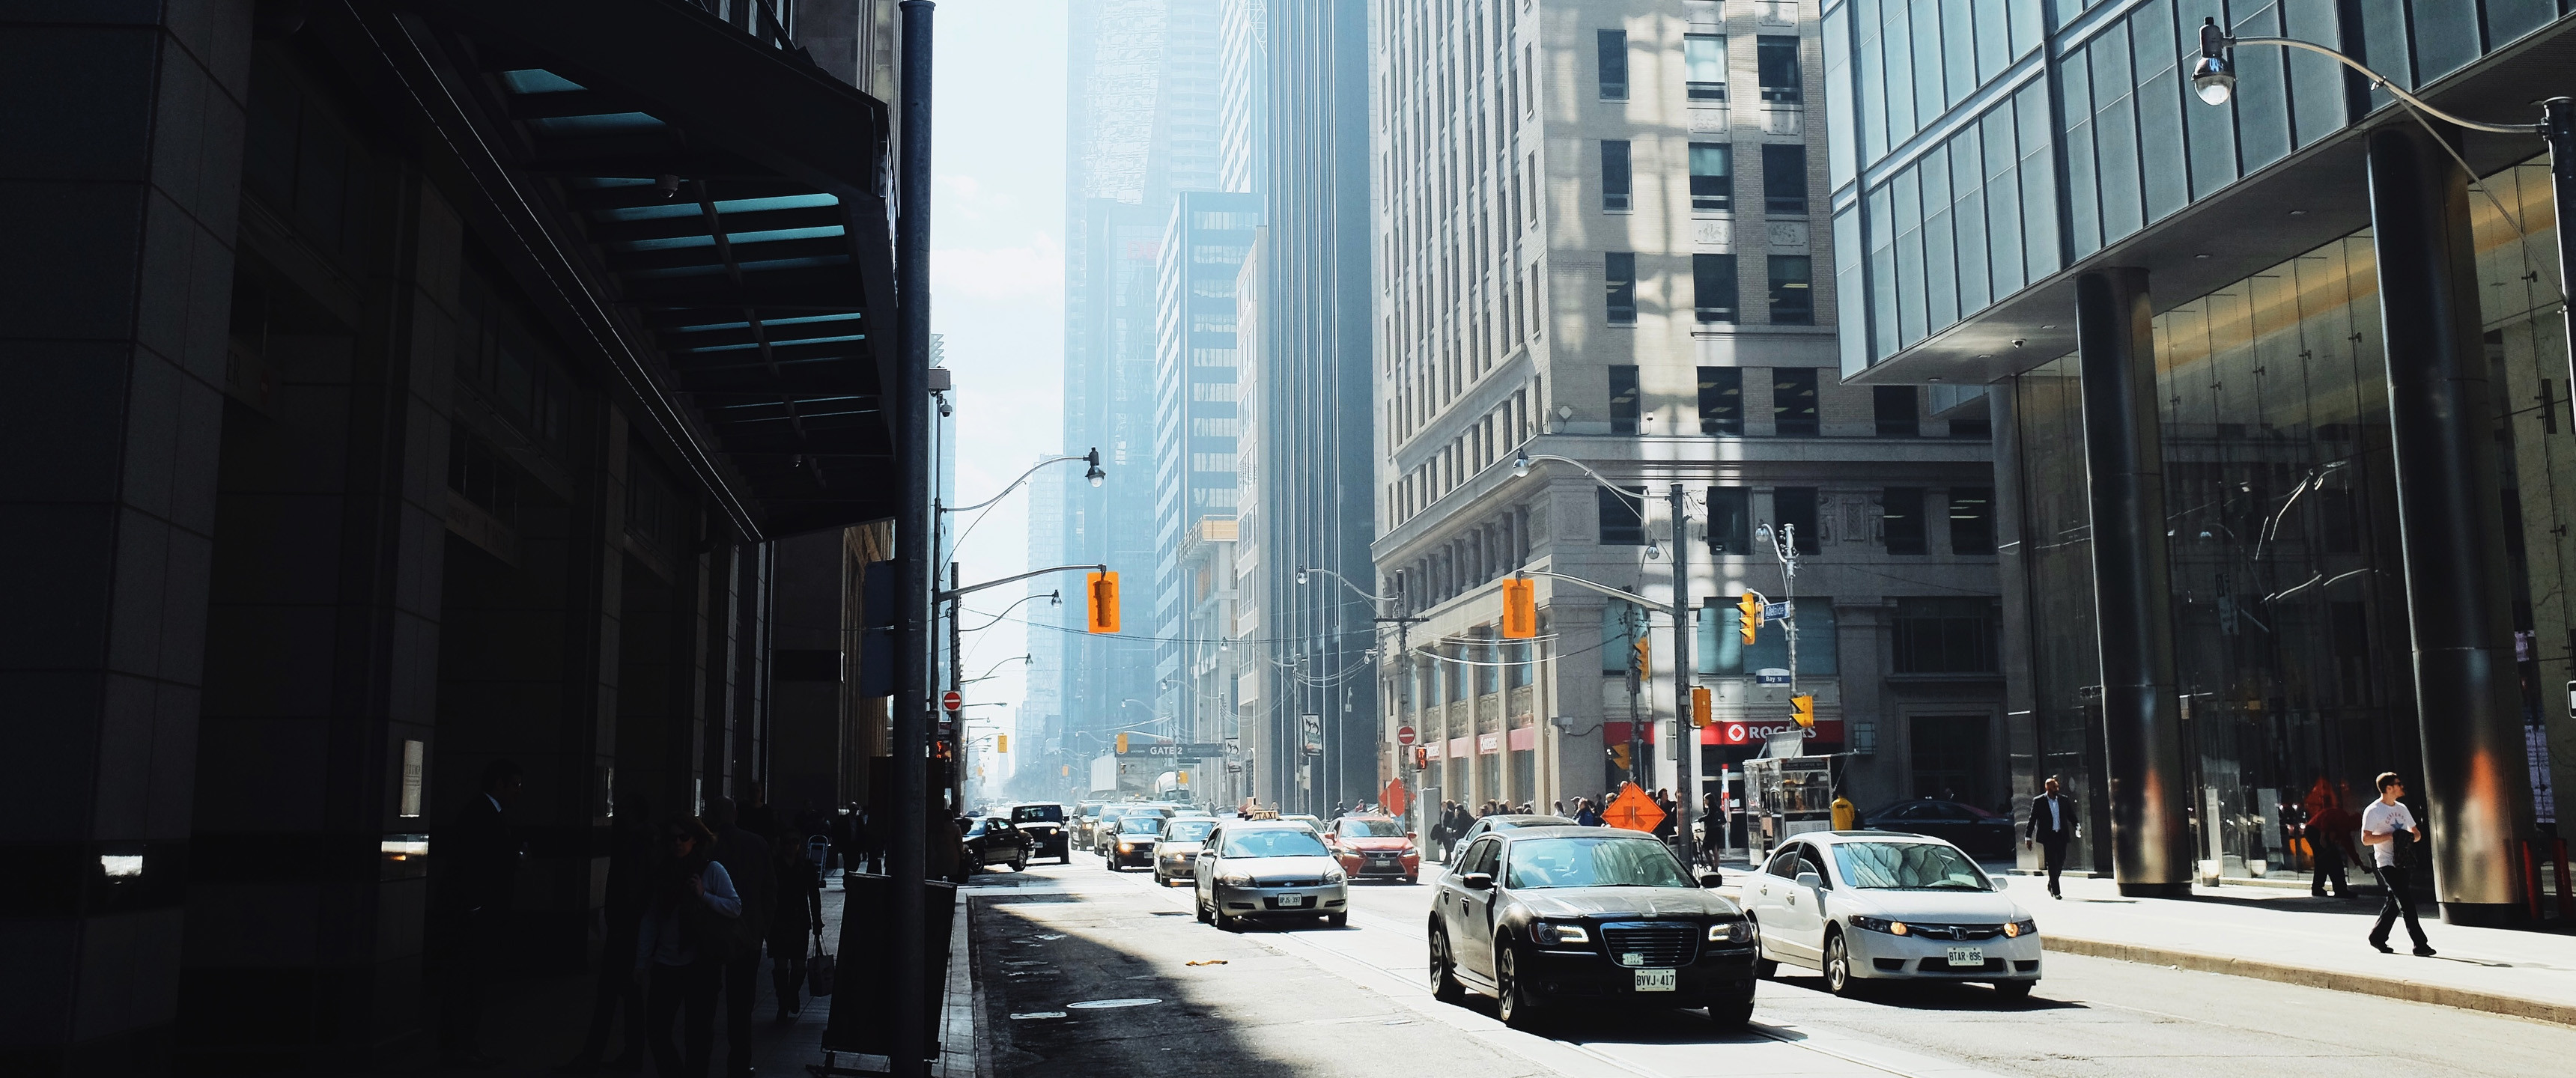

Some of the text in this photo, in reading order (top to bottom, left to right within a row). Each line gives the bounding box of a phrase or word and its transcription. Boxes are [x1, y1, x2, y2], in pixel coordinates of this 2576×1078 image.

[1749, 725, 1817, 739] ROGS
[1149, 746, 1174, 755] GATE
[1177, 746, 1182, 755] 2
[1948, 951, 1966, 961] BTAR
[1636, 975, 1674, 986] BVVJ 417
